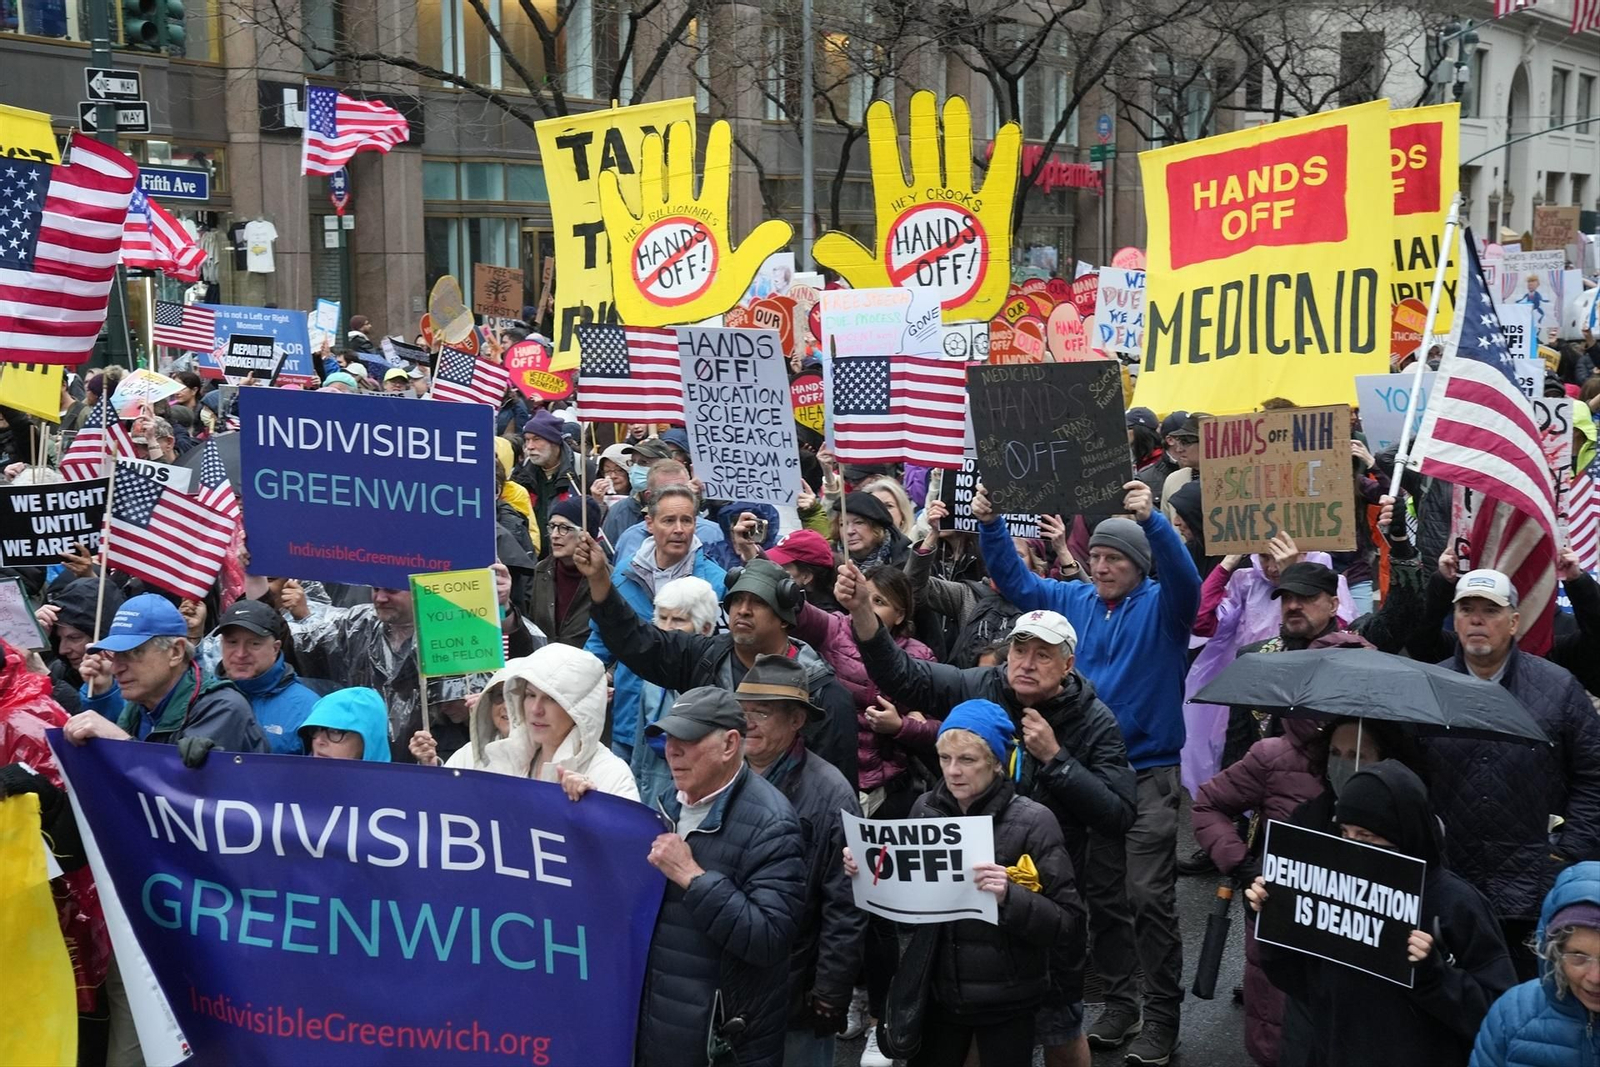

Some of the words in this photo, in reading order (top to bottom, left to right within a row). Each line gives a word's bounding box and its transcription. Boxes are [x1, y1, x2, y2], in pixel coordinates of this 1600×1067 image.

[96, 79, 110, 90] ONE
[120, 81, 135, 91] WAY
[121, 112, 141, 123] WAY
[141, 174, 171, 192] Fifth
[173, 177, 196, 193] Ave
[1193, 155, 1328, 212] HANDS
[891, 192, 918, 212] HEY
[926, 188, 983, 213] CROOKS
[1220, 198, 1296, 242] OFF
[622, 222, 646, 243] HEY
[895, 214, 977, 256] HANDS
[636, 222, 707, 271] HANDS
[657, 244, 708, 289] OFF!
[916, 248, 977, 287] OFF!
[1504, 262, 1518, 272] THE
[272, 314, 290, 324] Right
[477, 304, 519, 318] THIRSTY
[756, 309, 780, 328] OUR
[1007, 301, 1025, 318] OUR
[1109, 309, 1128, 324] WE
[1144, 267, 1379, 373] MEDICAID
[236, 322, 263, 330] Moment
[908, 306, 940, 336] GONE
[1055, 321, 1084, 335] HANDS
[232, 343, 258, 356] REPAIR
[258, 345, 272, 357] THIS
[287, 343, 304, 355] OR
[514, 344, 542, 357] HANDS
[678, 331, 774, 359] HANDS
[1017, 333, 1041, 353] OUR
[1065, 336, 1088, 353] OFF!
[226, 356, 254, 368] BROKEN
[511, 356, 542, 368] OFF!
[529, 371, 566, 388] VETERANS
[981, 366, 1046, 386] MEDICAID
[687, 383, 783, 406] EDUCATION
[791, 380, 824, 394] HANDS
[798, 392, 824, 404] OFF!
[986, 383, 1086, 432] HANDS
[696, 402, 782, 426] SCIENCE
[695, 424, 792, 448] RESEARCH
[1051, 414, 1094, 440] TRANS
[1204, 418, 1267, 459] HANDS
[1268, 429, 1288, 443] OFF
[1293, 412, 1334, 452] NIH
[257, 414, 478, 464] INDIVISIBLE
[1084, 437, 1105, 453] OUR
[696, 444, 780, 468] FREEDOM
[785, 458, 799, 468] OF
[712, 465, 782, 488] SPEECH
[956, 474, 974, 487] NO
[1224, 460, 1322, 500] SCIENCE
[10, 494, 42, 512] WE
[46, 487, 106, 512] FIGHT
[254, 468, 481, 518] GREENWICH
[704, 482, 794, 503] DIVERSITY
[955, 489, 972, 502] NO
[992, 480, 1022, 504] OUR
[1074, 481, 1098, 497] OUR
[954, 504, 972, 516] NO
[31, 512, 92, 534] UNTIL
[954, 518, 978, 530] NOT
[1010, 523, 1041, 538] NAME
[1208, 503, 1278, 542] SAVES
[1282, 502, 1343, 538] LIVES
[2, 539, 33, 557] WE
[36, 536, 76, 556] ARE
[289, 541, 452, 571] IndivisibleGreenwich.org
[423, 584, 440, 595] BE
[444, 580, 480, 593] GONE
[426, 611, 454, 622] YOU
[458, 607, 488, 618] TWO
[430, 638, 464, 650] ELON
[470, 636, 479, 646] &
[432, 653, 449, 664] the
[452, 648, 494, 660] FELON
[137, 791, 573, 888] INDIVISIBLE
[858, 822, 962, 846] HANDS
[1264, 853, 1420, 926] DEHUMANIZATION
[140, 872, 590, 981] GREENWICH
[1294, 894, 1314, 926] IS
[1316, 901, 1385, 948] DEADLY
[188, 985, 551, 1066] IndivisibleGreenwich.org
